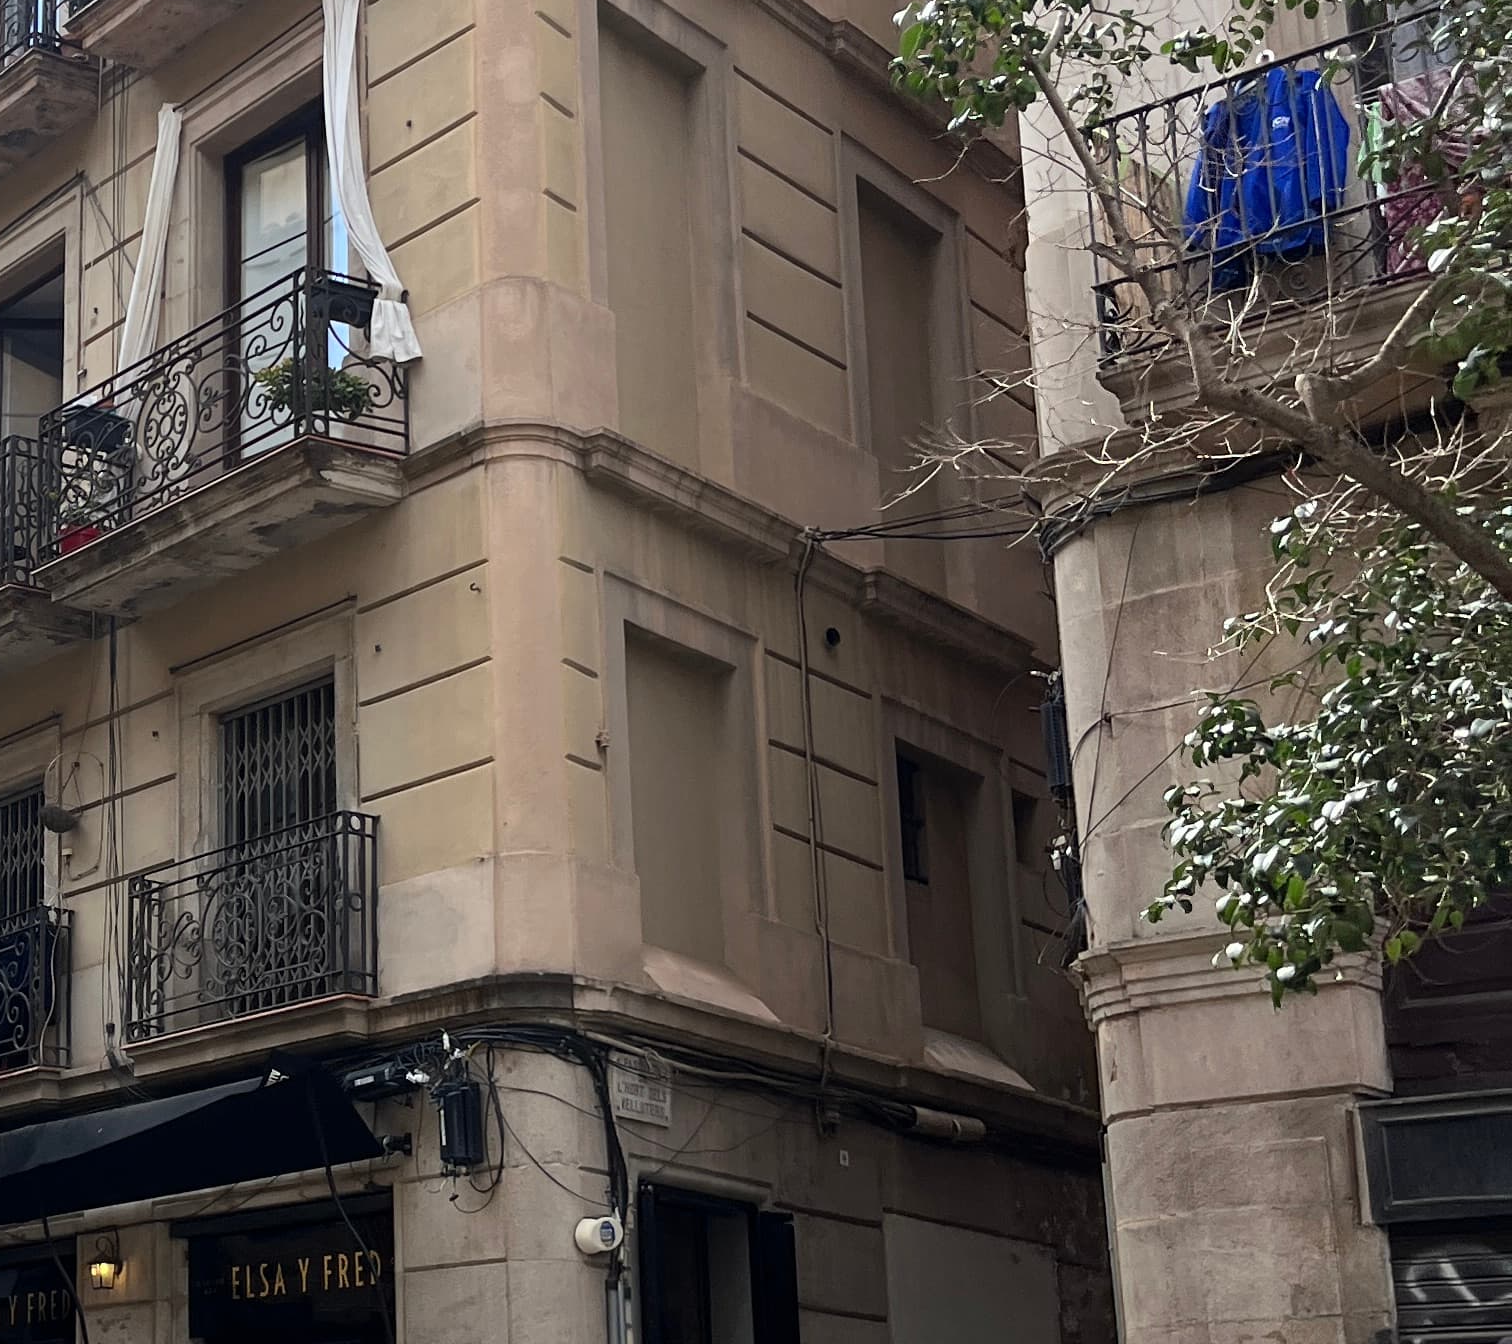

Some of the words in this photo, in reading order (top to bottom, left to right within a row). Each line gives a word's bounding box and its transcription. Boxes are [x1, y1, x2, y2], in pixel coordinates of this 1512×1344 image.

[232, 1263, 286, 1300] ELSA
[298, 1257, 309, 1293] Y
[323, 1250, 381, 1291] FRED
[9, 1295, 18, 1325] Y
[27, 1288, 71, 1324] FRED
